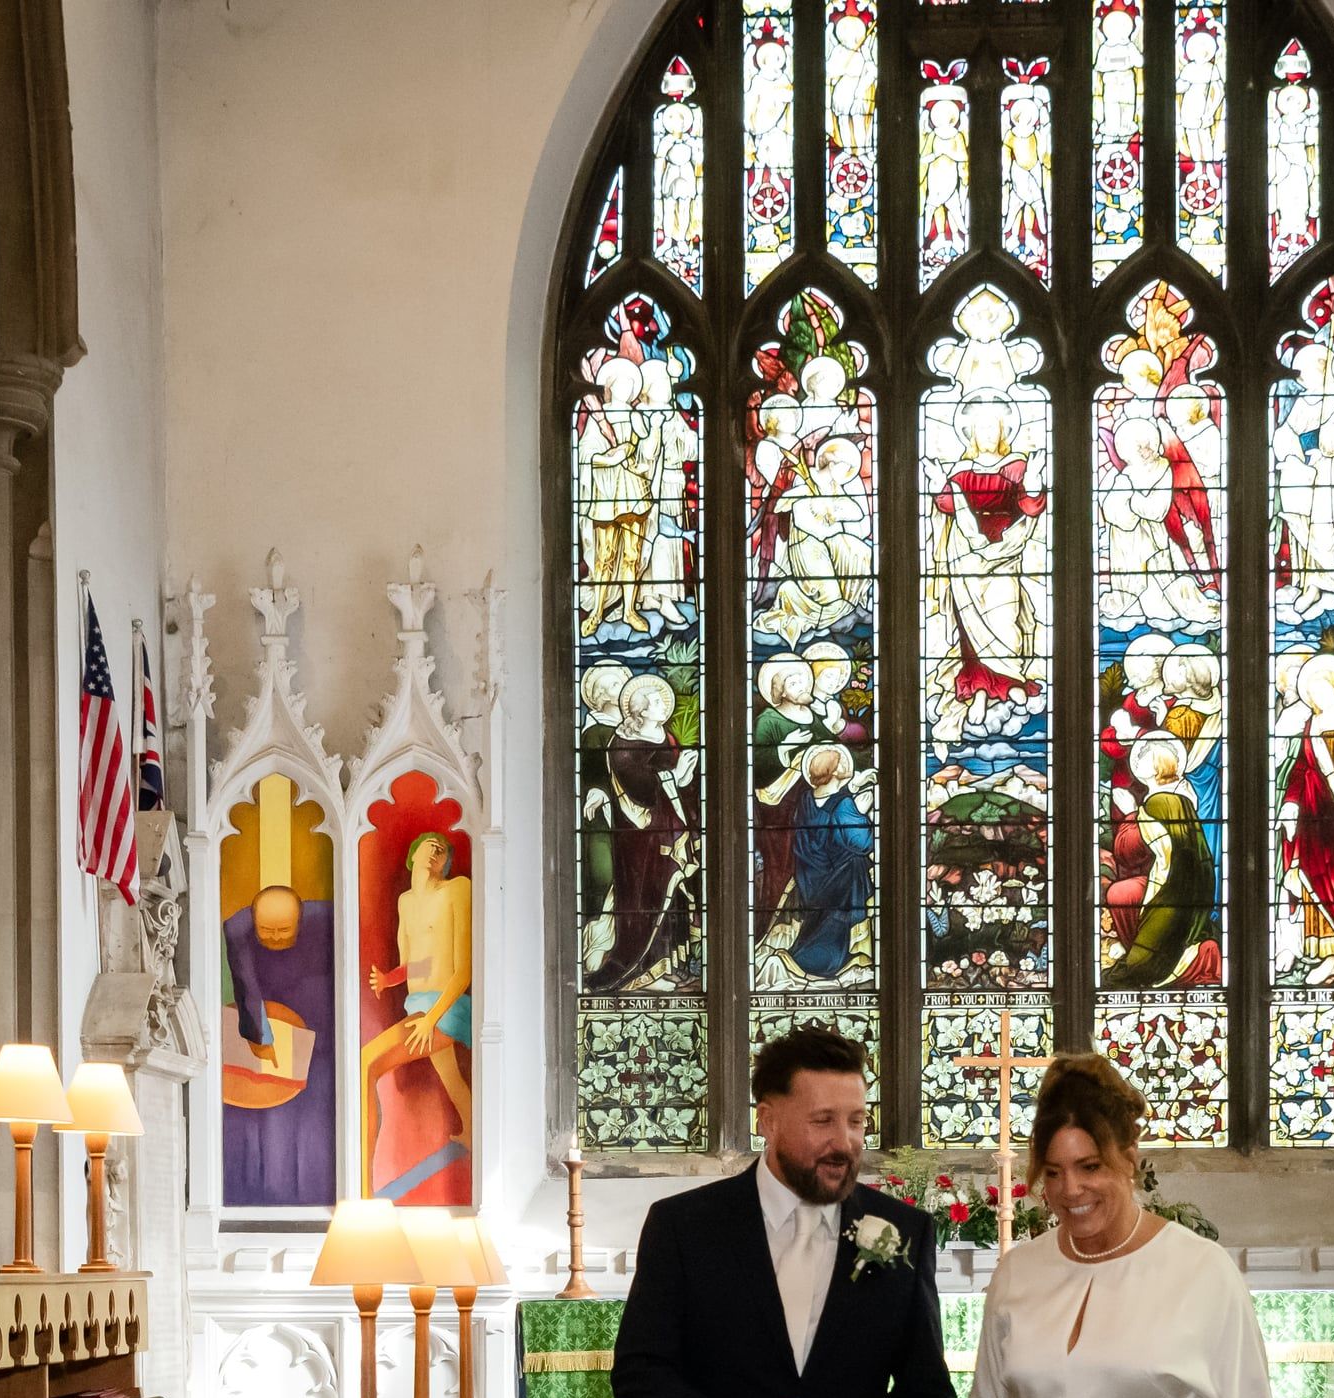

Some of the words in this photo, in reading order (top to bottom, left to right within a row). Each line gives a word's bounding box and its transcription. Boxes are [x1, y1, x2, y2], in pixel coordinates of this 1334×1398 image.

[925, 996, 951, 1005] FROM
[959, 996, 977, 1005] YOU
[986, 995, 1006, 1004] INTO
[1015, 995, 1051, 1004] HEAVEN
[1108, 994, 1140, 1004] SHALL
[1155, 994, 1170, 1003] SO
[1187, 993, 1214, 1002] COME
[1283, 992, 1294, 1001] IN
[1307, 992, 1332, 1001] LIKE
[592, 1000, 615, 1009] THIS
[629, 1000, 656, 1009] SAME
[758, 998, 784, 1006] WHICH
[796, 998, 805, 1006] IS
[814, 997, 846, 1006] TAKEN
[857, 997, 869, 1006] UP
